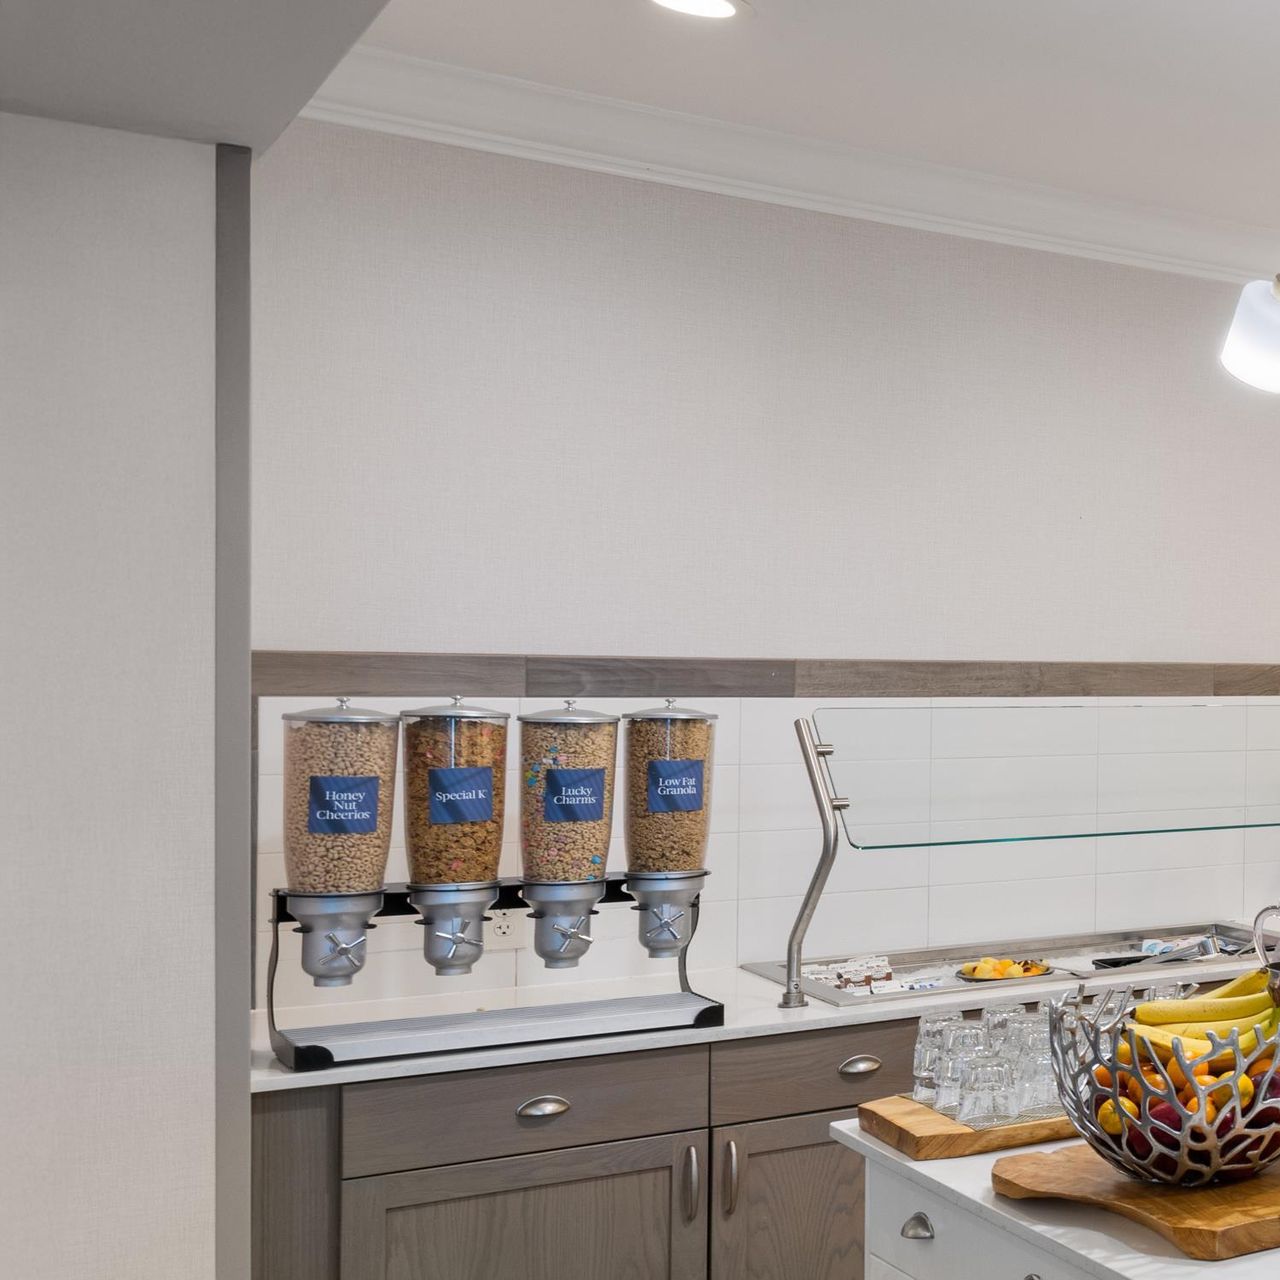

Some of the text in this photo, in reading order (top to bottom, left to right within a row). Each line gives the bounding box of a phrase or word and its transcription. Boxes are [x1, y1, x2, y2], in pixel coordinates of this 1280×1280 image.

[659, 777, 696, 786] Low Fat
[562, 787, 593, 797] Lucky
[658, 785, 697, 795] Granola
[326, 791, 366, 802] Honey
[436, 790, 487, 802] Special K
[554, 795, 597, 805] Charms
[335, 801, 357, 810] Nut
[316, 810, 371, 820] Cheerios
